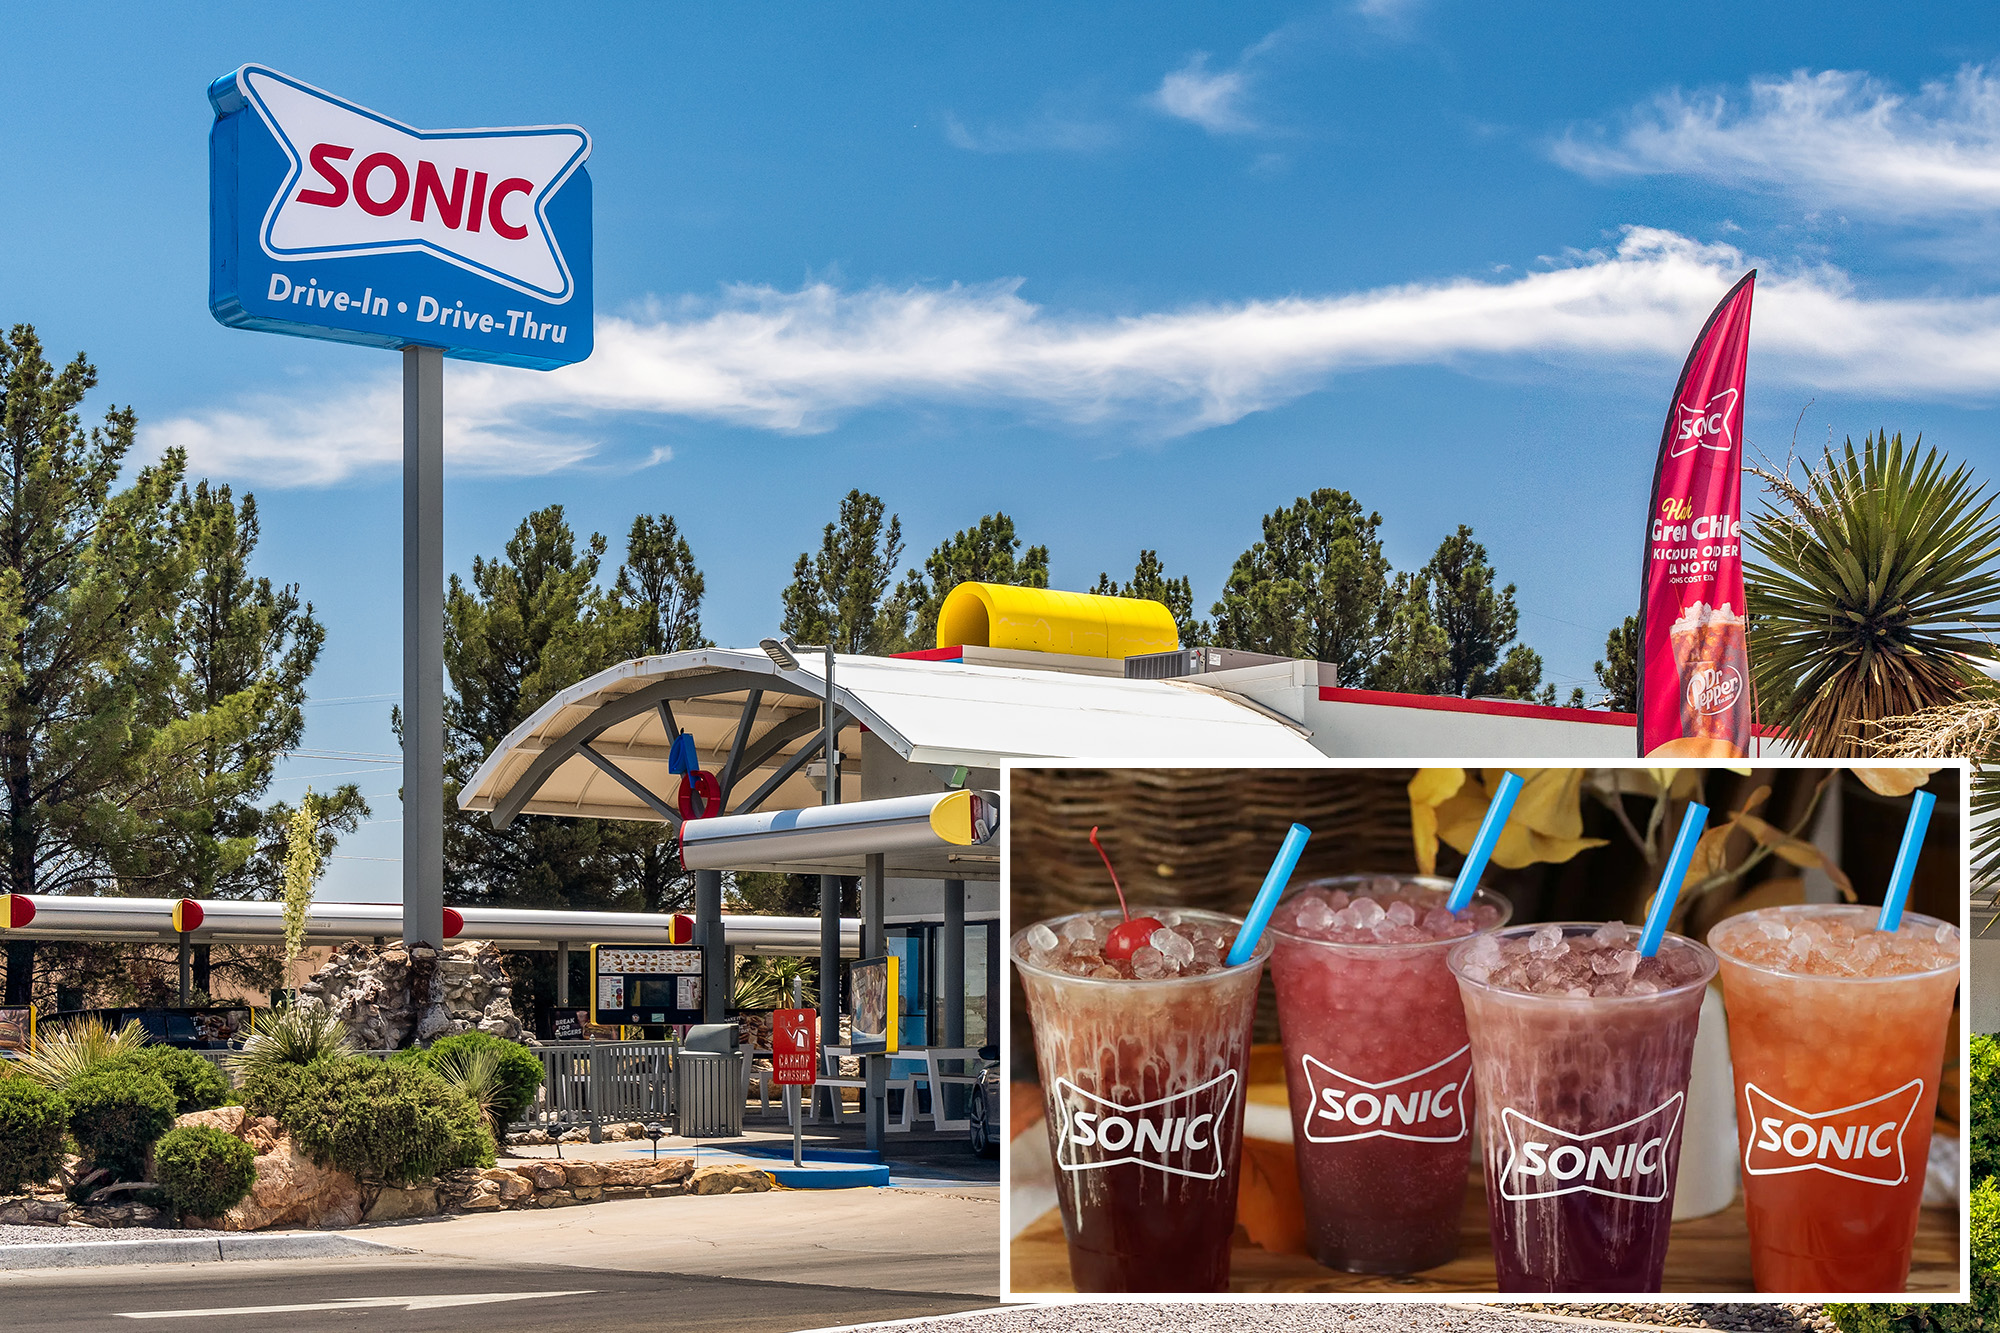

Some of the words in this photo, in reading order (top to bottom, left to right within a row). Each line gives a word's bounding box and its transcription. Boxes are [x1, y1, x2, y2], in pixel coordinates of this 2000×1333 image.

[296, 143, 534, 240] SONIC
[267, 273, 388, 316] Drive-In
[417, 295, 567, 344] Drive-Thru
[1688, 672, 1738, 710] Pepper
[1704, 668, 1723, 690] Dr
[559, 1029, 582, 1037] URGERS
[778, 1054, 810, 1068] CARHOP
[778, 1069, 810, 1081] CROSSING
[1318, 1082, 1457, 1126] SONIC
[1071, 1112, 1213, 1153] SONIC
[1758, 1118, 1897, 1160] SONIC
[1517, 1137, 1662, 1180] SONIC
